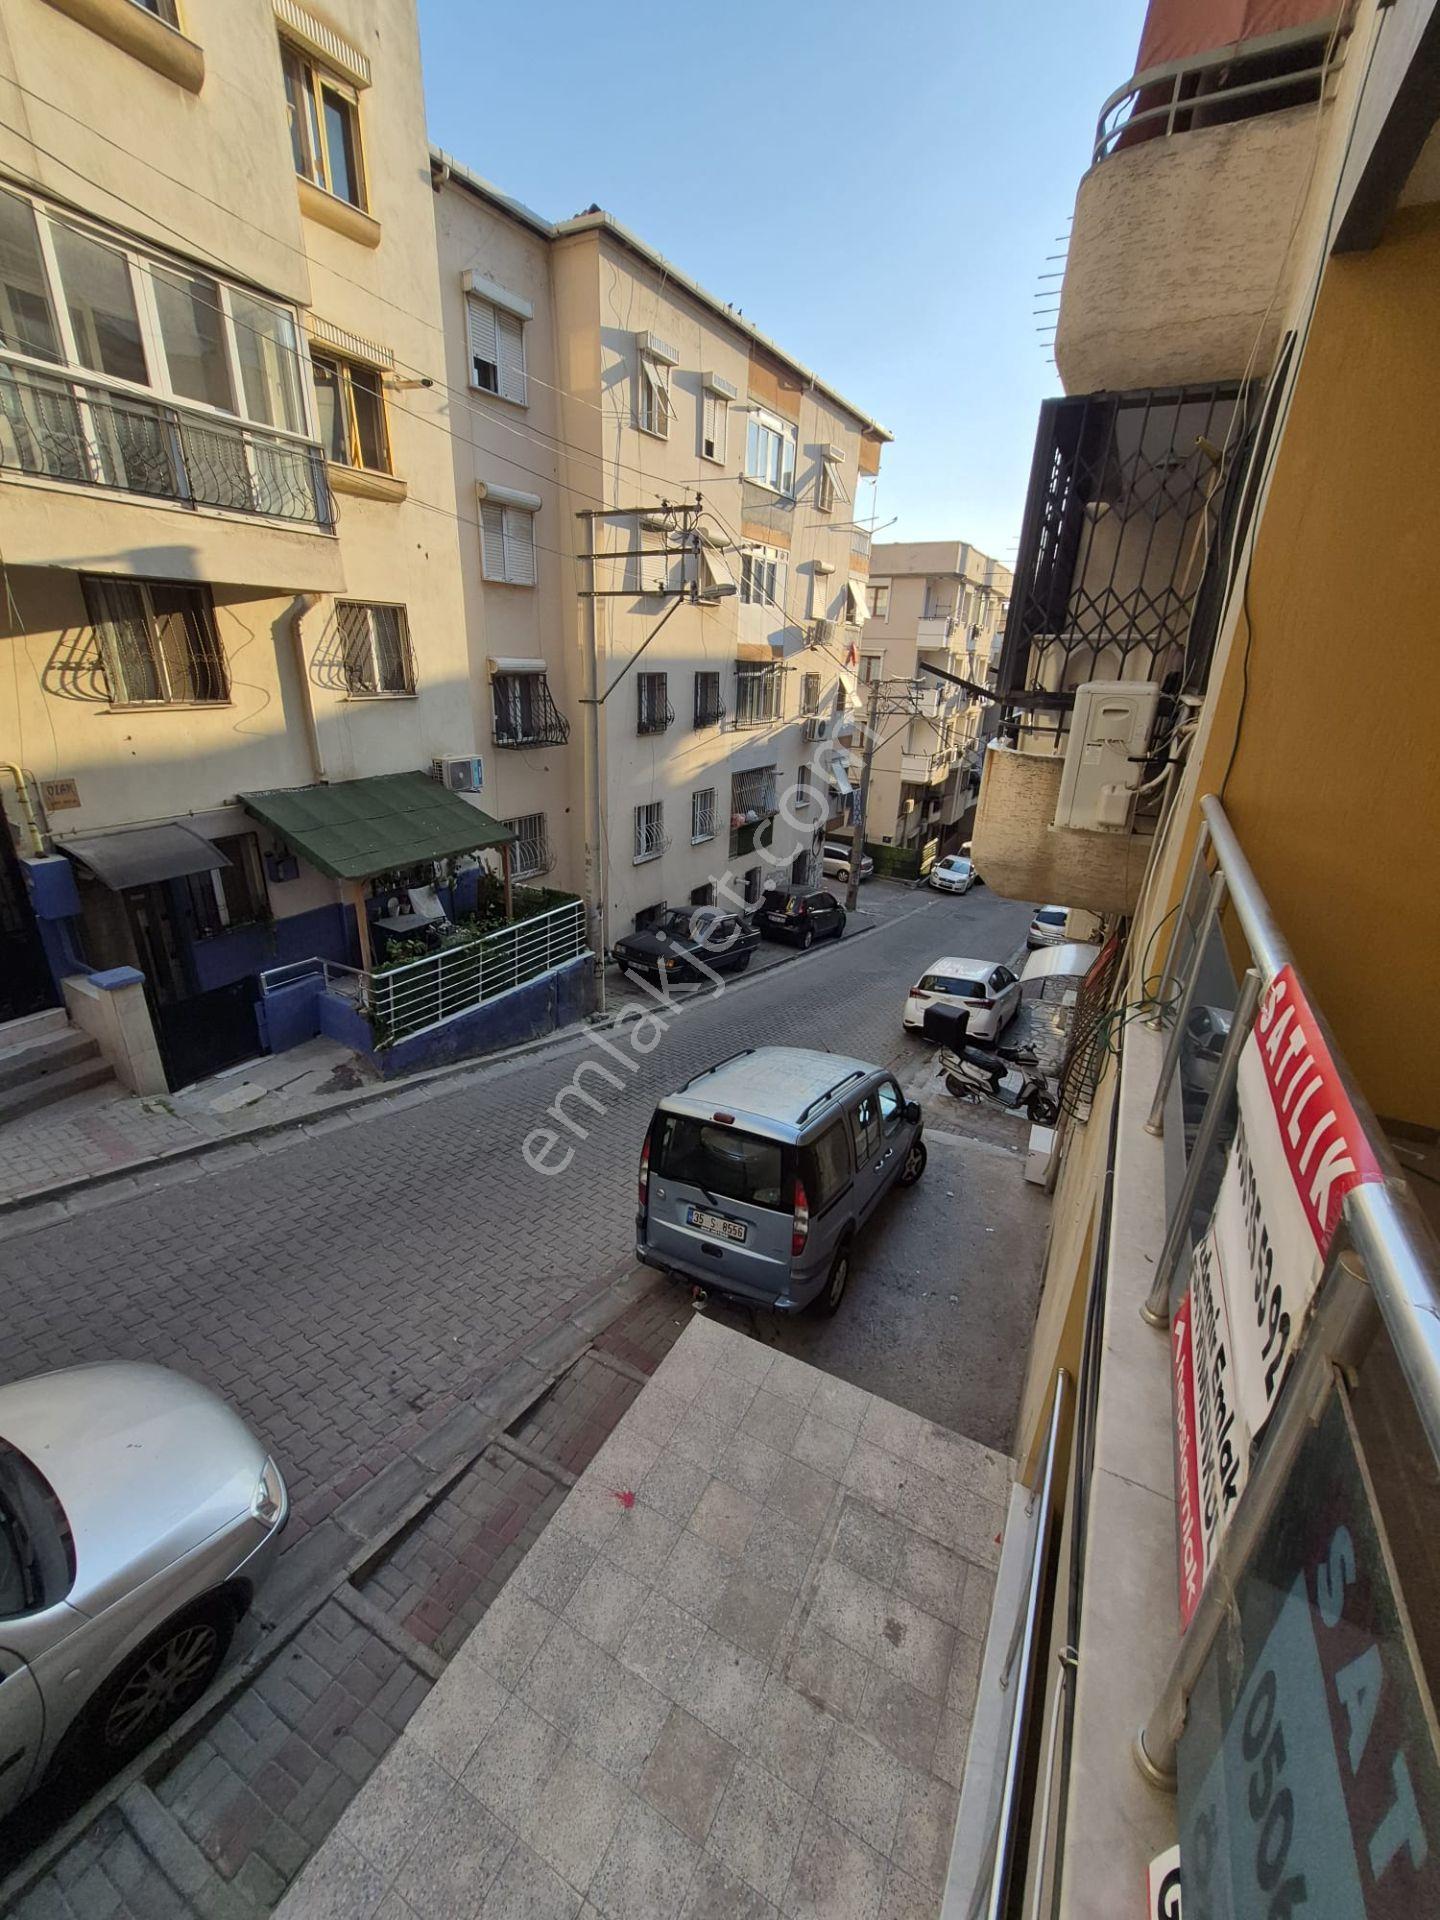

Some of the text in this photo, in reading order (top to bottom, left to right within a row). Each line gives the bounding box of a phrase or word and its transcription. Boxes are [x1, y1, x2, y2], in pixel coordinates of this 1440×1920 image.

[1260, 981, 1356, 1229] SATILIK
[694, 1213, 704, 1224] 35
[710, 1217, 716, 1228] S
[1211, 1342, 1240, 1516] Emlak
